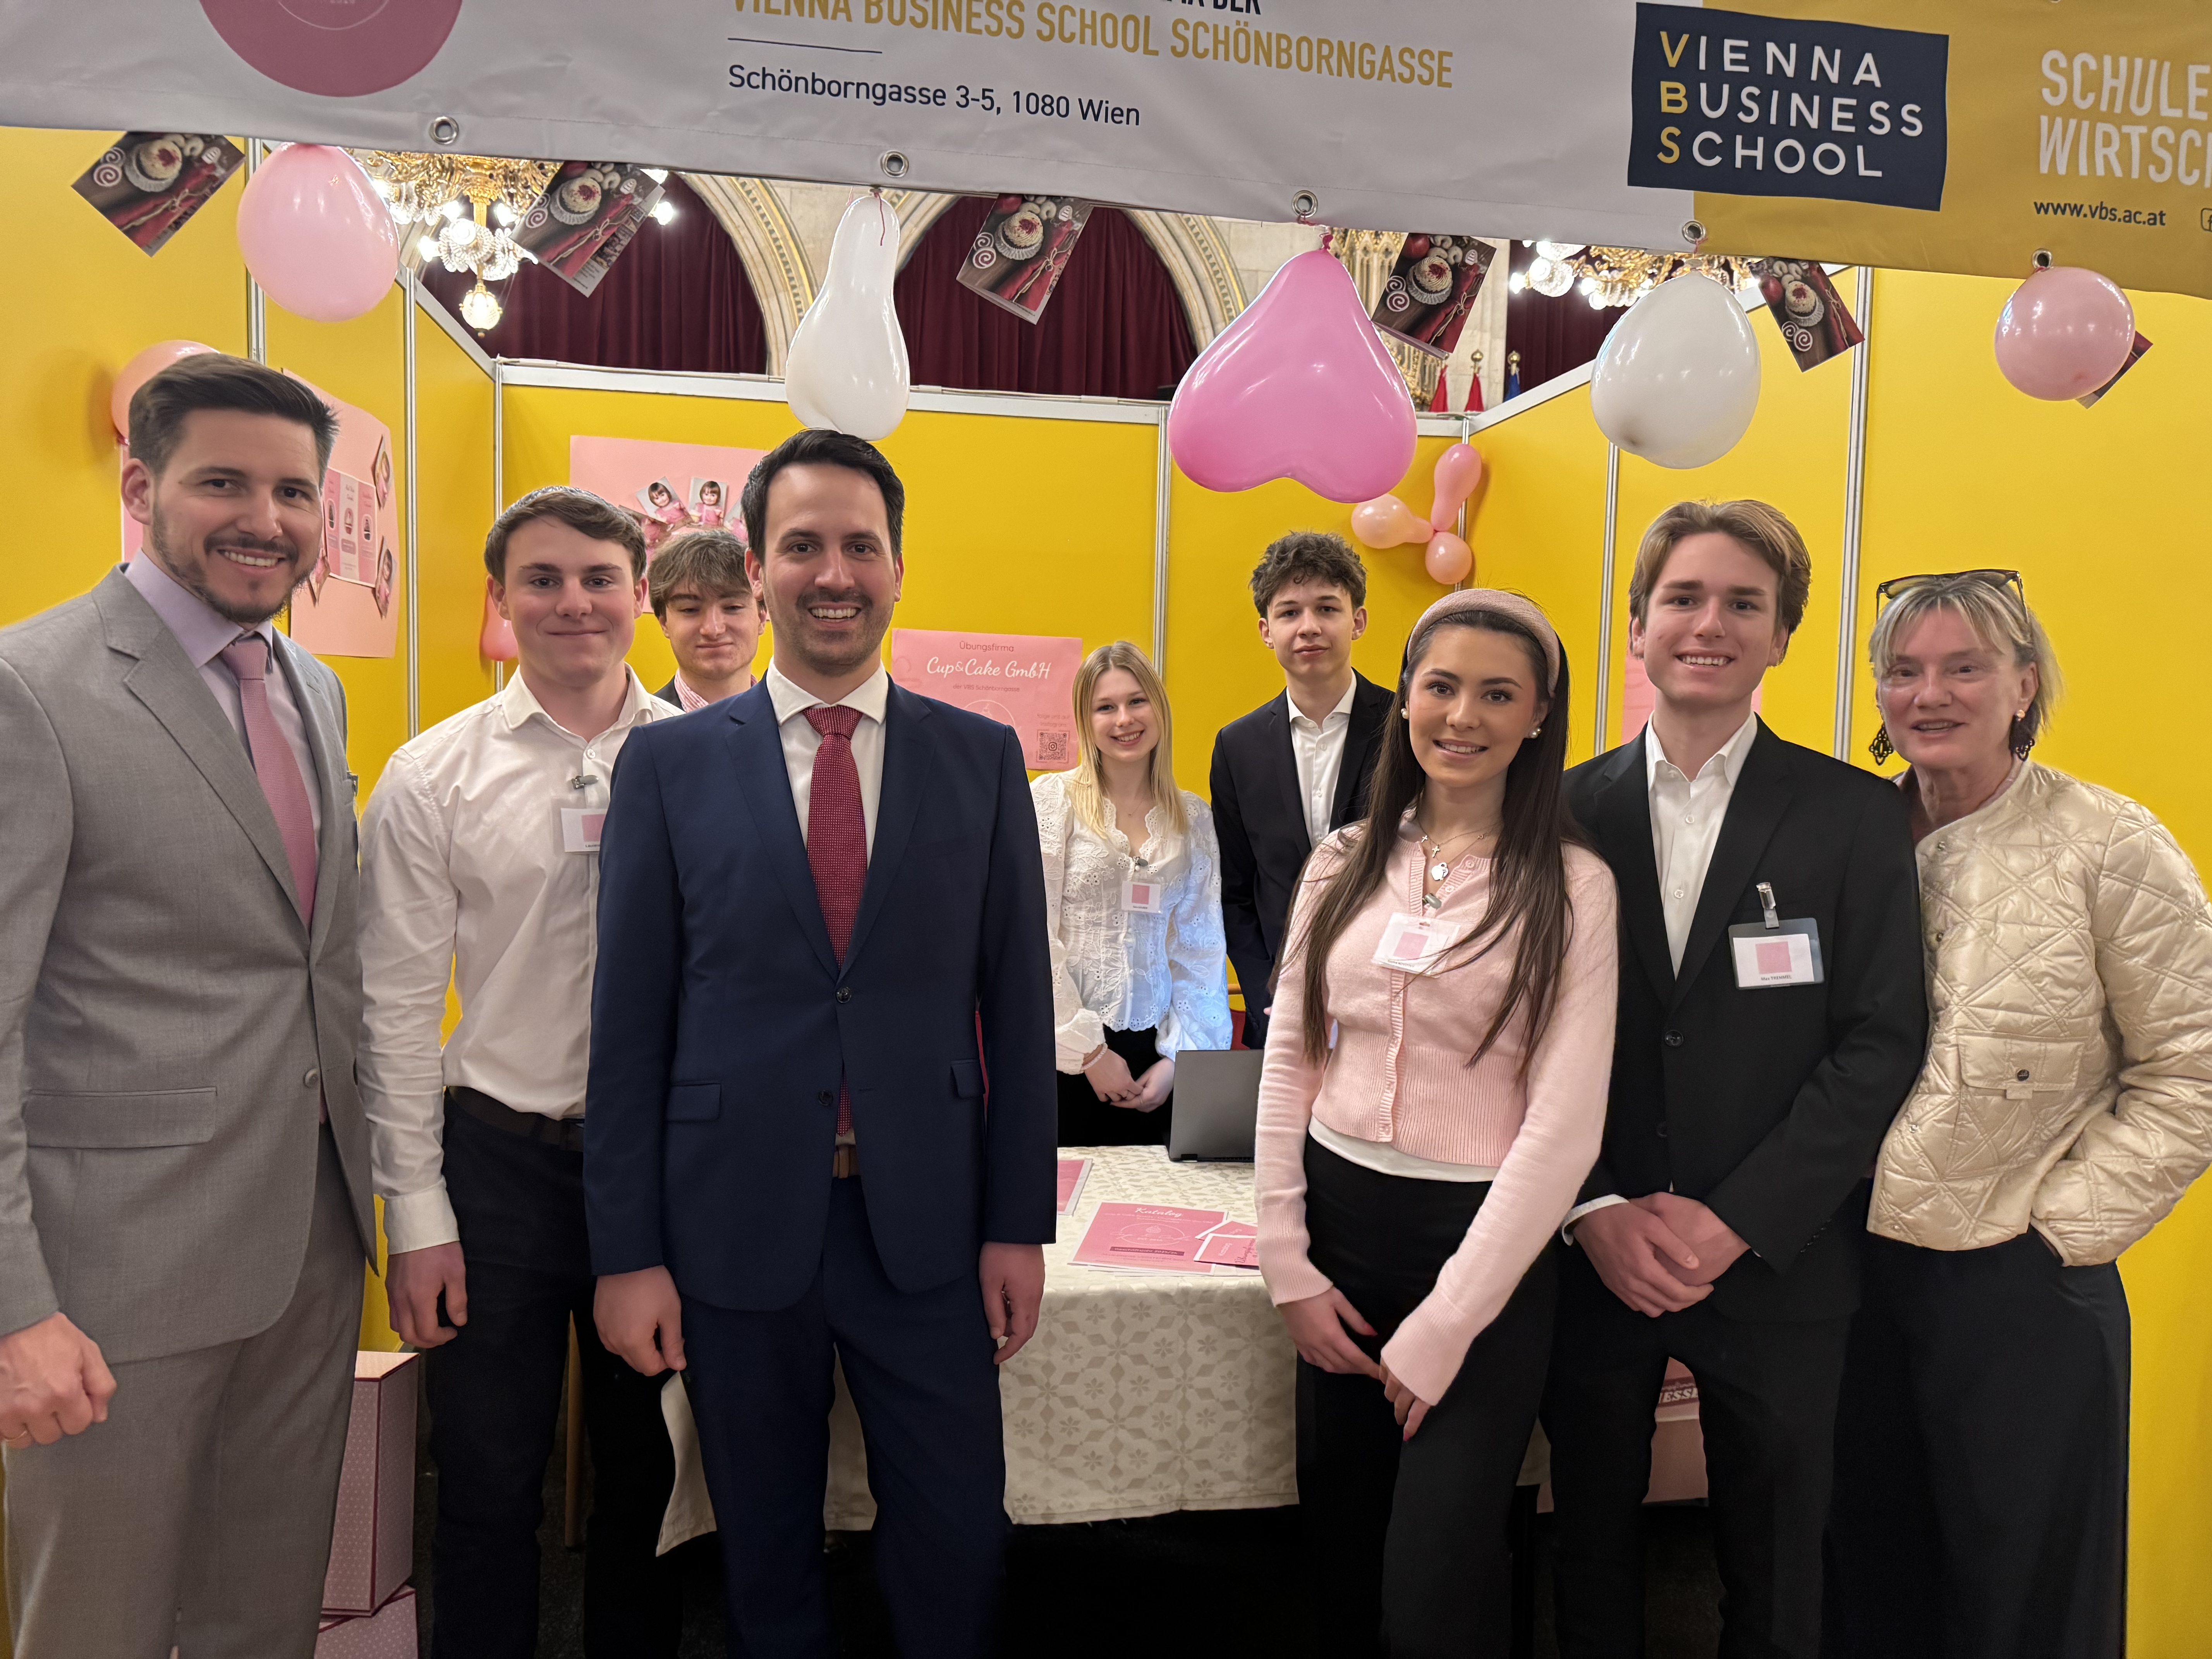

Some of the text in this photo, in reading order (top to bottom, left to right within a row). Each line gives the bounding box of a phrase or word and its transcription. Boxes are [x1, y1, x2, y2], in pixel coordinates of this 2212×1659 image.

[735, 0, 1453, 88] NNA BUSINESS SCHOOL SCHÖNBORNGASSE
[1660, 31, 1881, 88] VIENNA
[728, 64, 1140, 125] Schönborngasse 3-5, 1080 Wien
[1660, 81, 1923, 136] BUSINESS
[2042, 50, 2210, 120] SCHULE
[1657, 127, 1882, 177] SCHOOL
[2034, 201, 2166, 226] www.vbs.ac.at
[927, 656, 1051, 679] Cup&Cake GmbH
[960, 641, 1014, 652] Übungsfirma
[1135, 1207, 1182, 1218] Katalog
[1659, 1388, 1698, 1403] ESS
